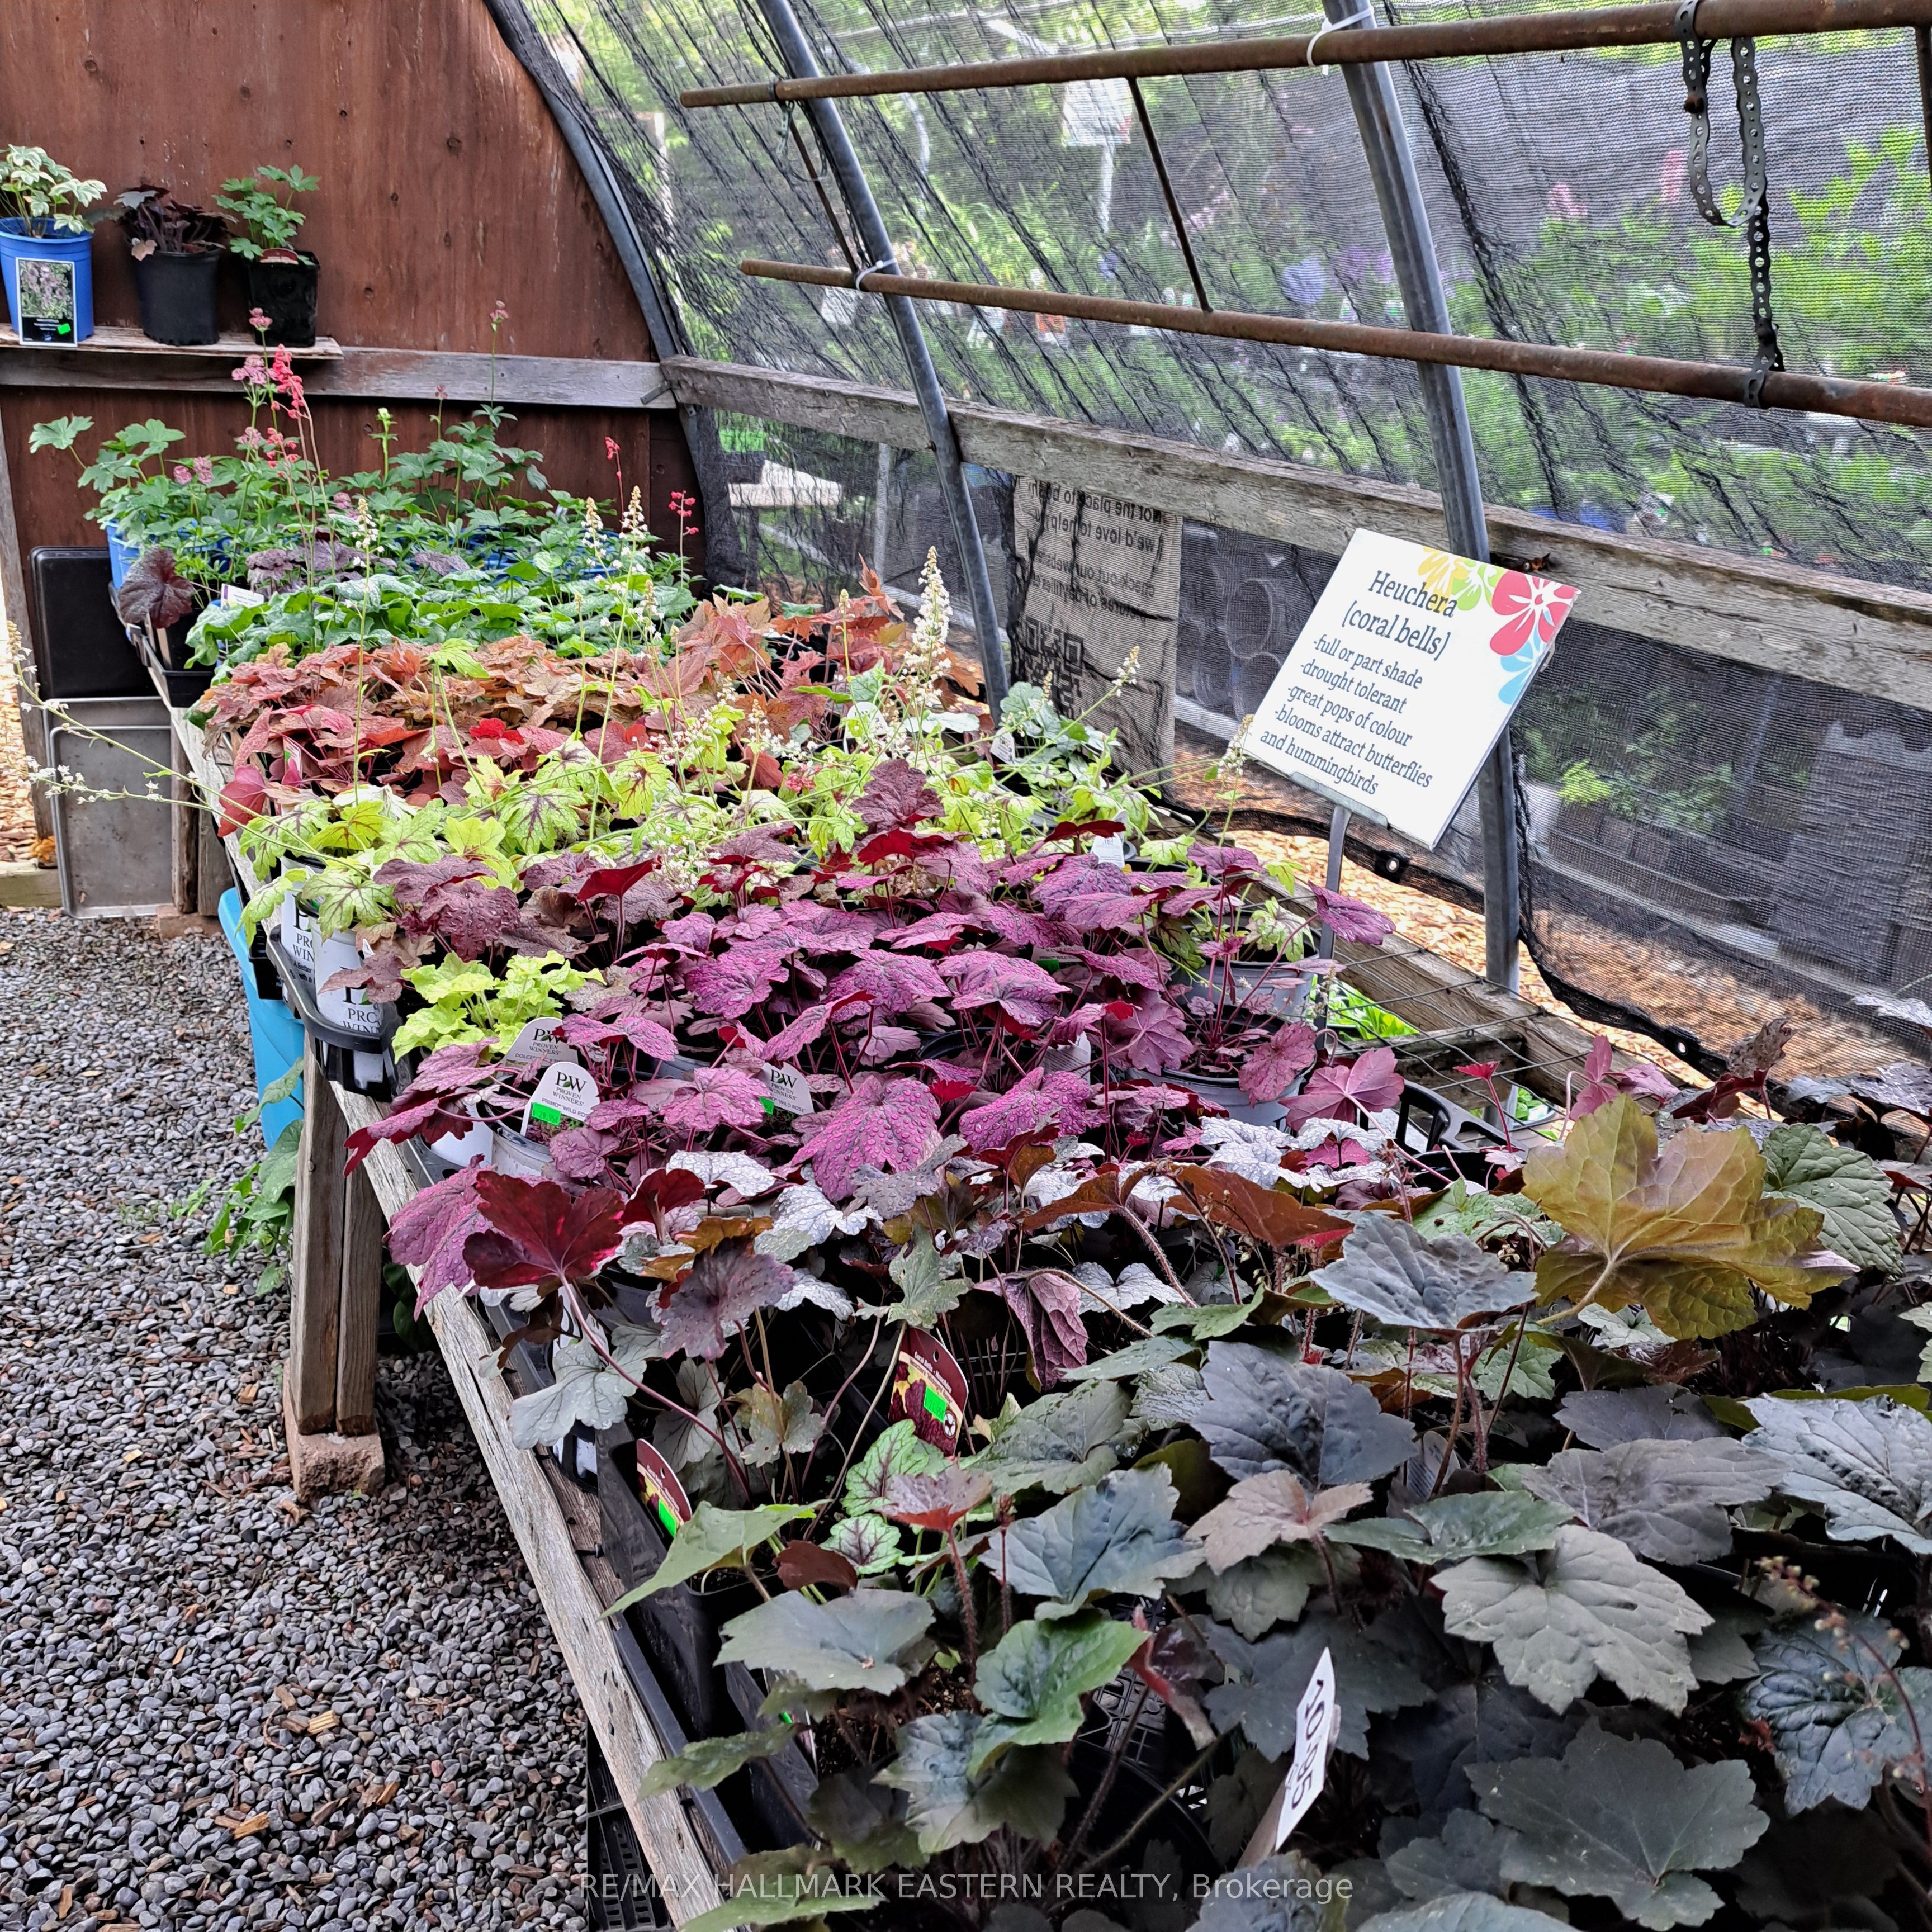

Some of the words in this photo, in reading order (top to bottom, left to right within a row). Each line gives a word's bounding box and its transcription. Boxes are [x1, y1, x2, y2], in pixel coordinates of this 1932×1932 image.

[1368, 570, 1458, 618] Heuchera
[1338, 648, 1355, 662] or
[1350, 653, 1384, 674] part
[1382, 661, 1423, 689] shade
[1353, 680, 1407, 714] tolerant
[1320, 699, 1355, 723] pops
[1354, 712, 1374, 729] of
[1369, 720, 1413, 747] colour
[1260, 730, 1289, 751] and
[1285, 737, 1379, 795] hummingbirds
[1322, 730, 1366, 758] attract
[1365, 743, 1433, 788] butterflies
[533, 1041, 559, 1050] PROVEN
[552, 1091, 584, 1106] WINNERS
[556, 1086, 581, 1099] PROVEN
[771, 1082, 794, 1095] PROVEN
